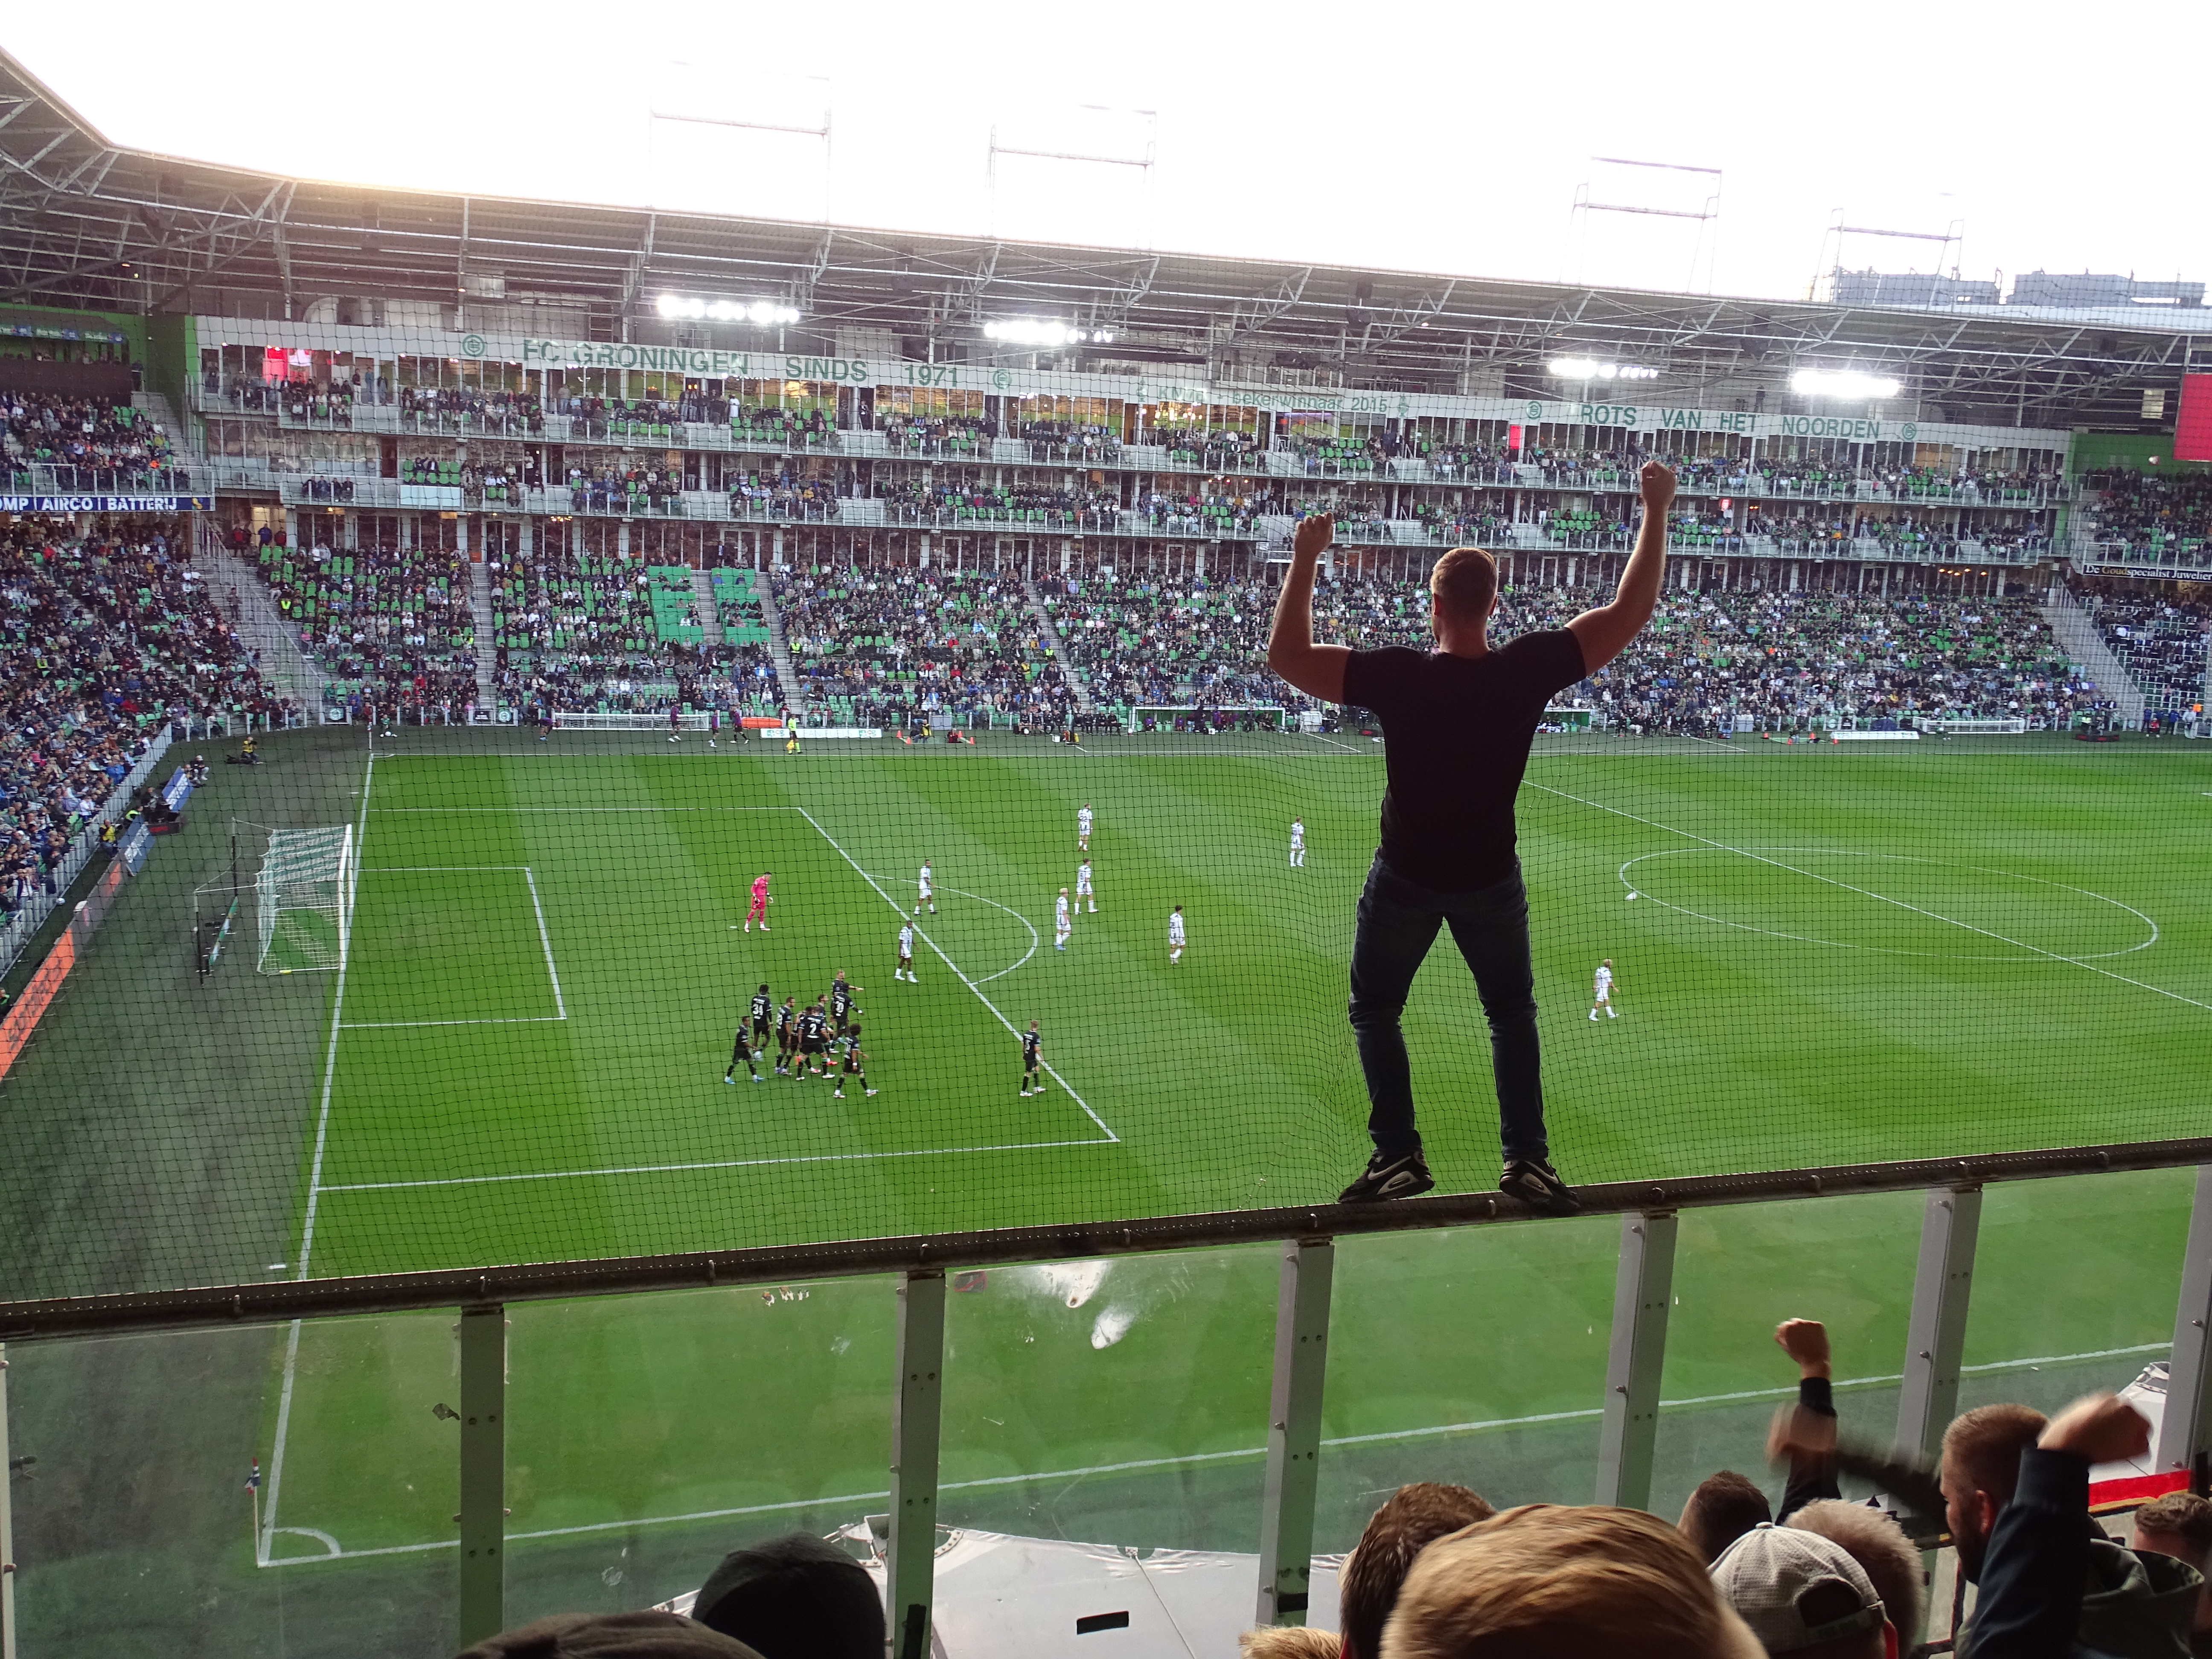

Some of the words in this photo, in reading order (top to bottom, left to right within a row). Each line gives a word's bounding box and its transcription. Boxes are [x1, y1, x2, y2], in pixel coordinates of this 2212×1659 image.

[524, 340, 560, 363] FC
[573, 343, 748, 374] GRONINGEN
[786, 356, 867, 382] SINDS
[905, 365, 957, 387] 1971
[1232, 390, 1343, 410] bekerwinnaar
[1352, 397, 1387, 412] 2015
[1580, 405, 1637, 425] ROTS
[1662, 408, 1701, 429] VAN
[1720, 413, 1757, 432] HET
[1782, 416, 1879, 439] NOORDEN
[43, 497, 93, 511] AIRCO
[107, 497, 178, 511] BATTERIJ
[2086, 565, 2100, 573] De
[2101, 566, 2169, 578] Goudspecialist
[752, 1003, 763, 1016] 34
[809, 1023, 817, 1035] 2
